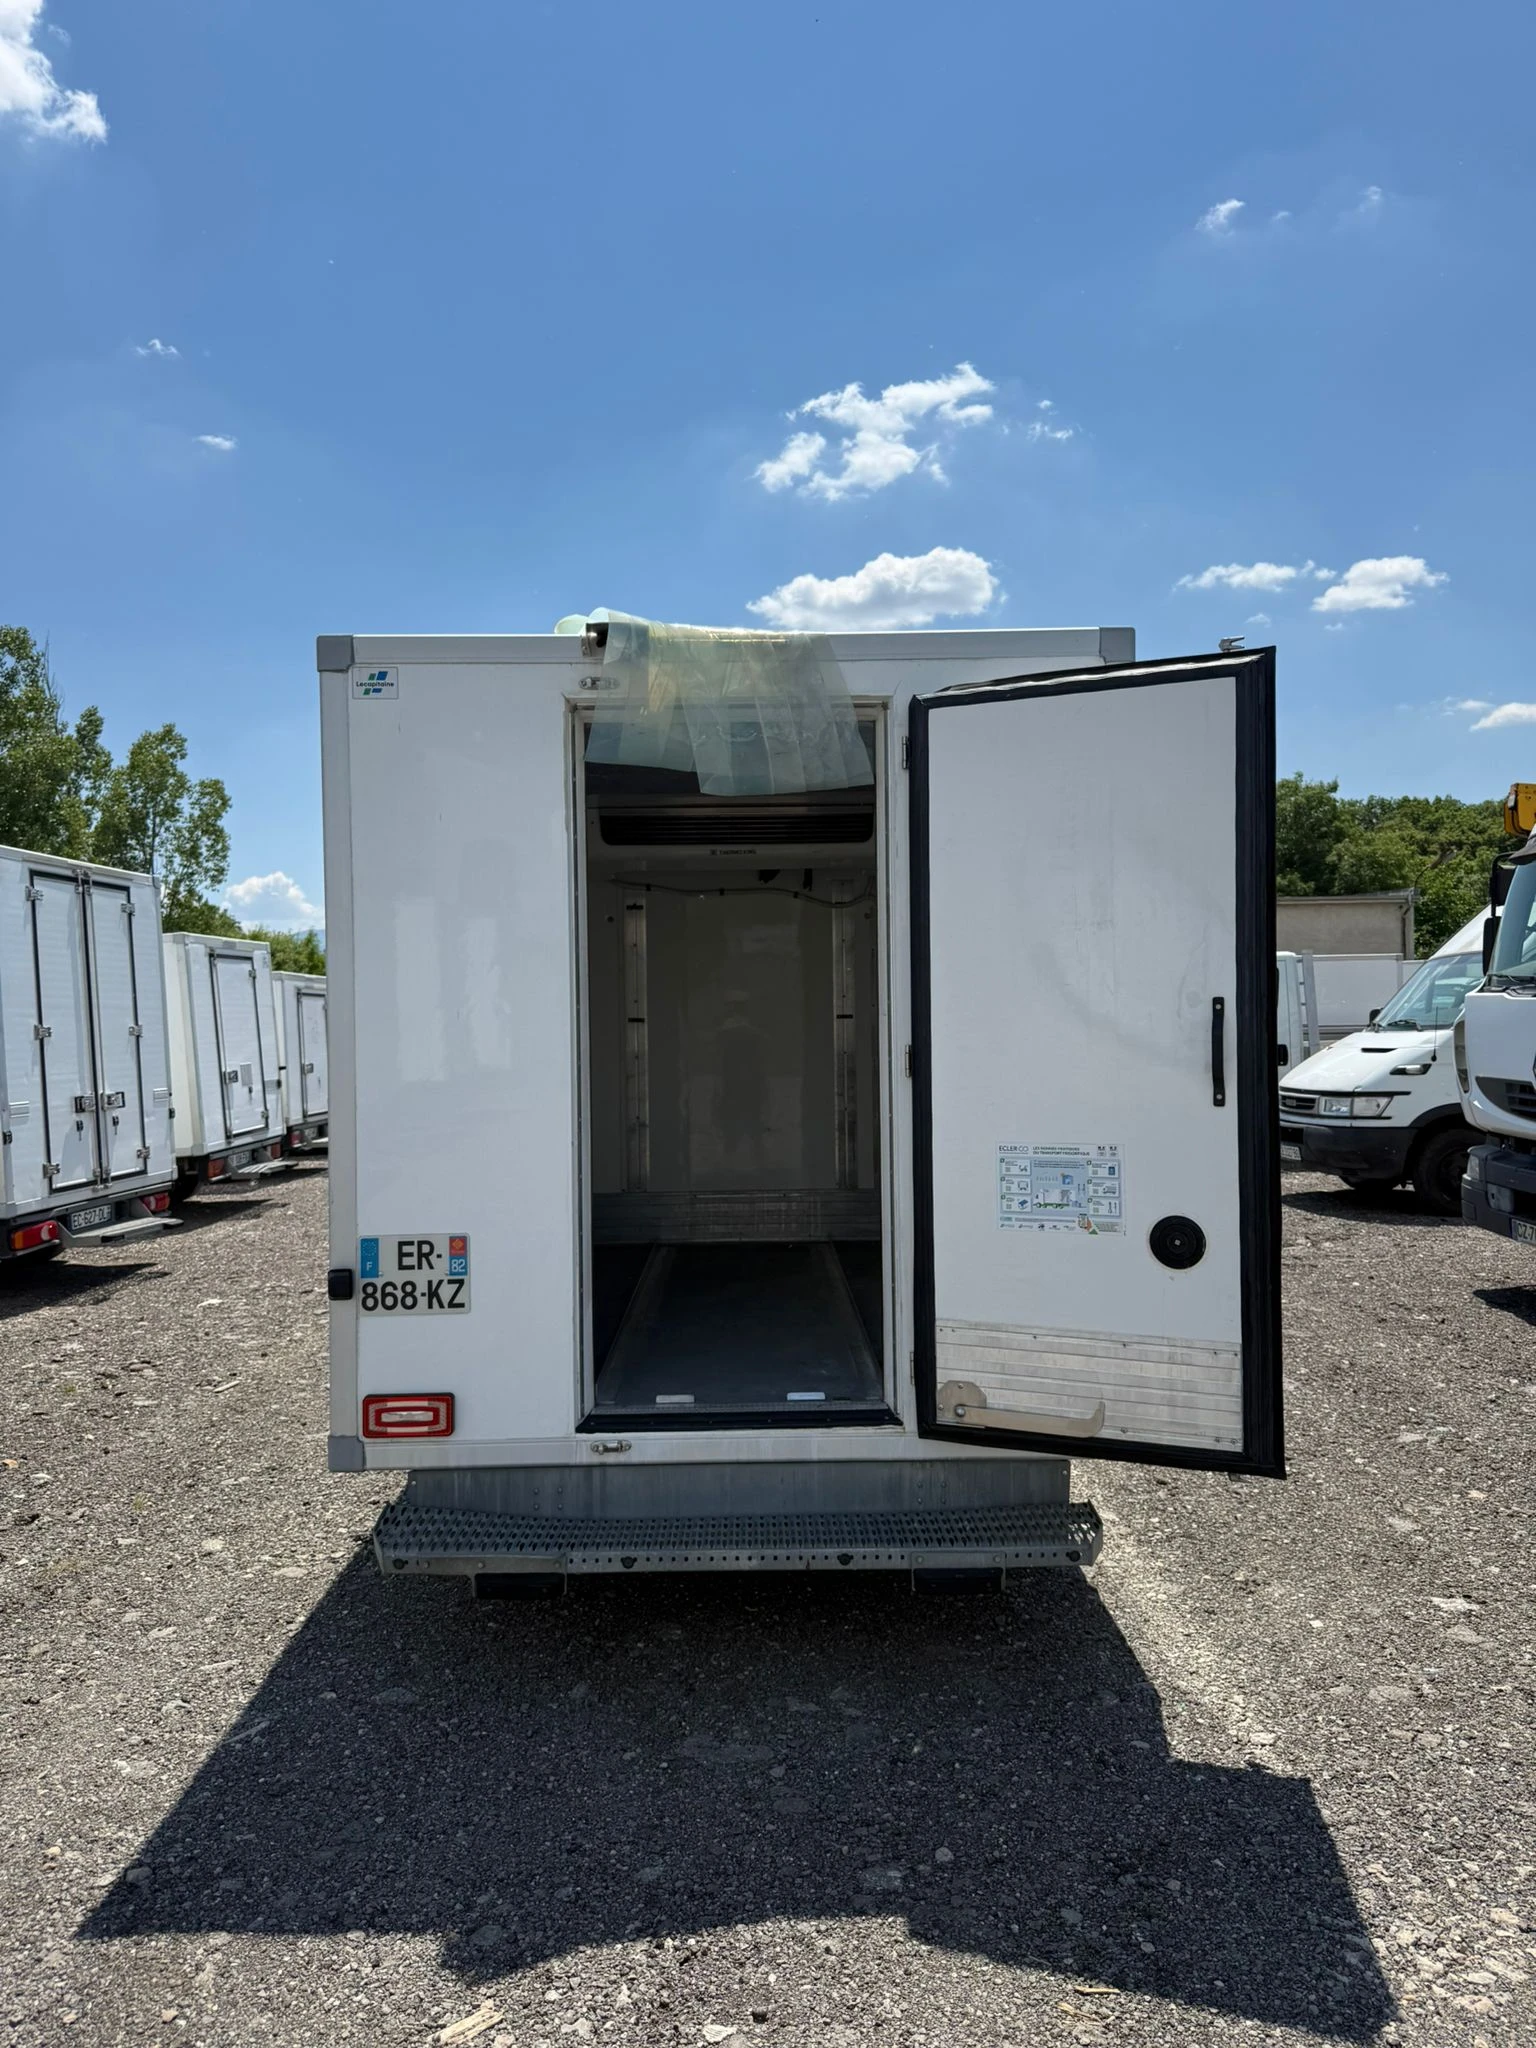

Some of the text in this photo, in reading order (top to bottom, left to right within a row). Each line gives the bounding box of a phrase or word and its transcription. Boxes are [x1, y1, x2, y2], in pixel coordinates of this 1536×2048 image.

[366, 1261, 373, 1271] F
[397, 1239, 443, 1271] ER-
[451, 1258, 466, 1273] 82
[361, 1278, 466, 1312] 868-KZ
